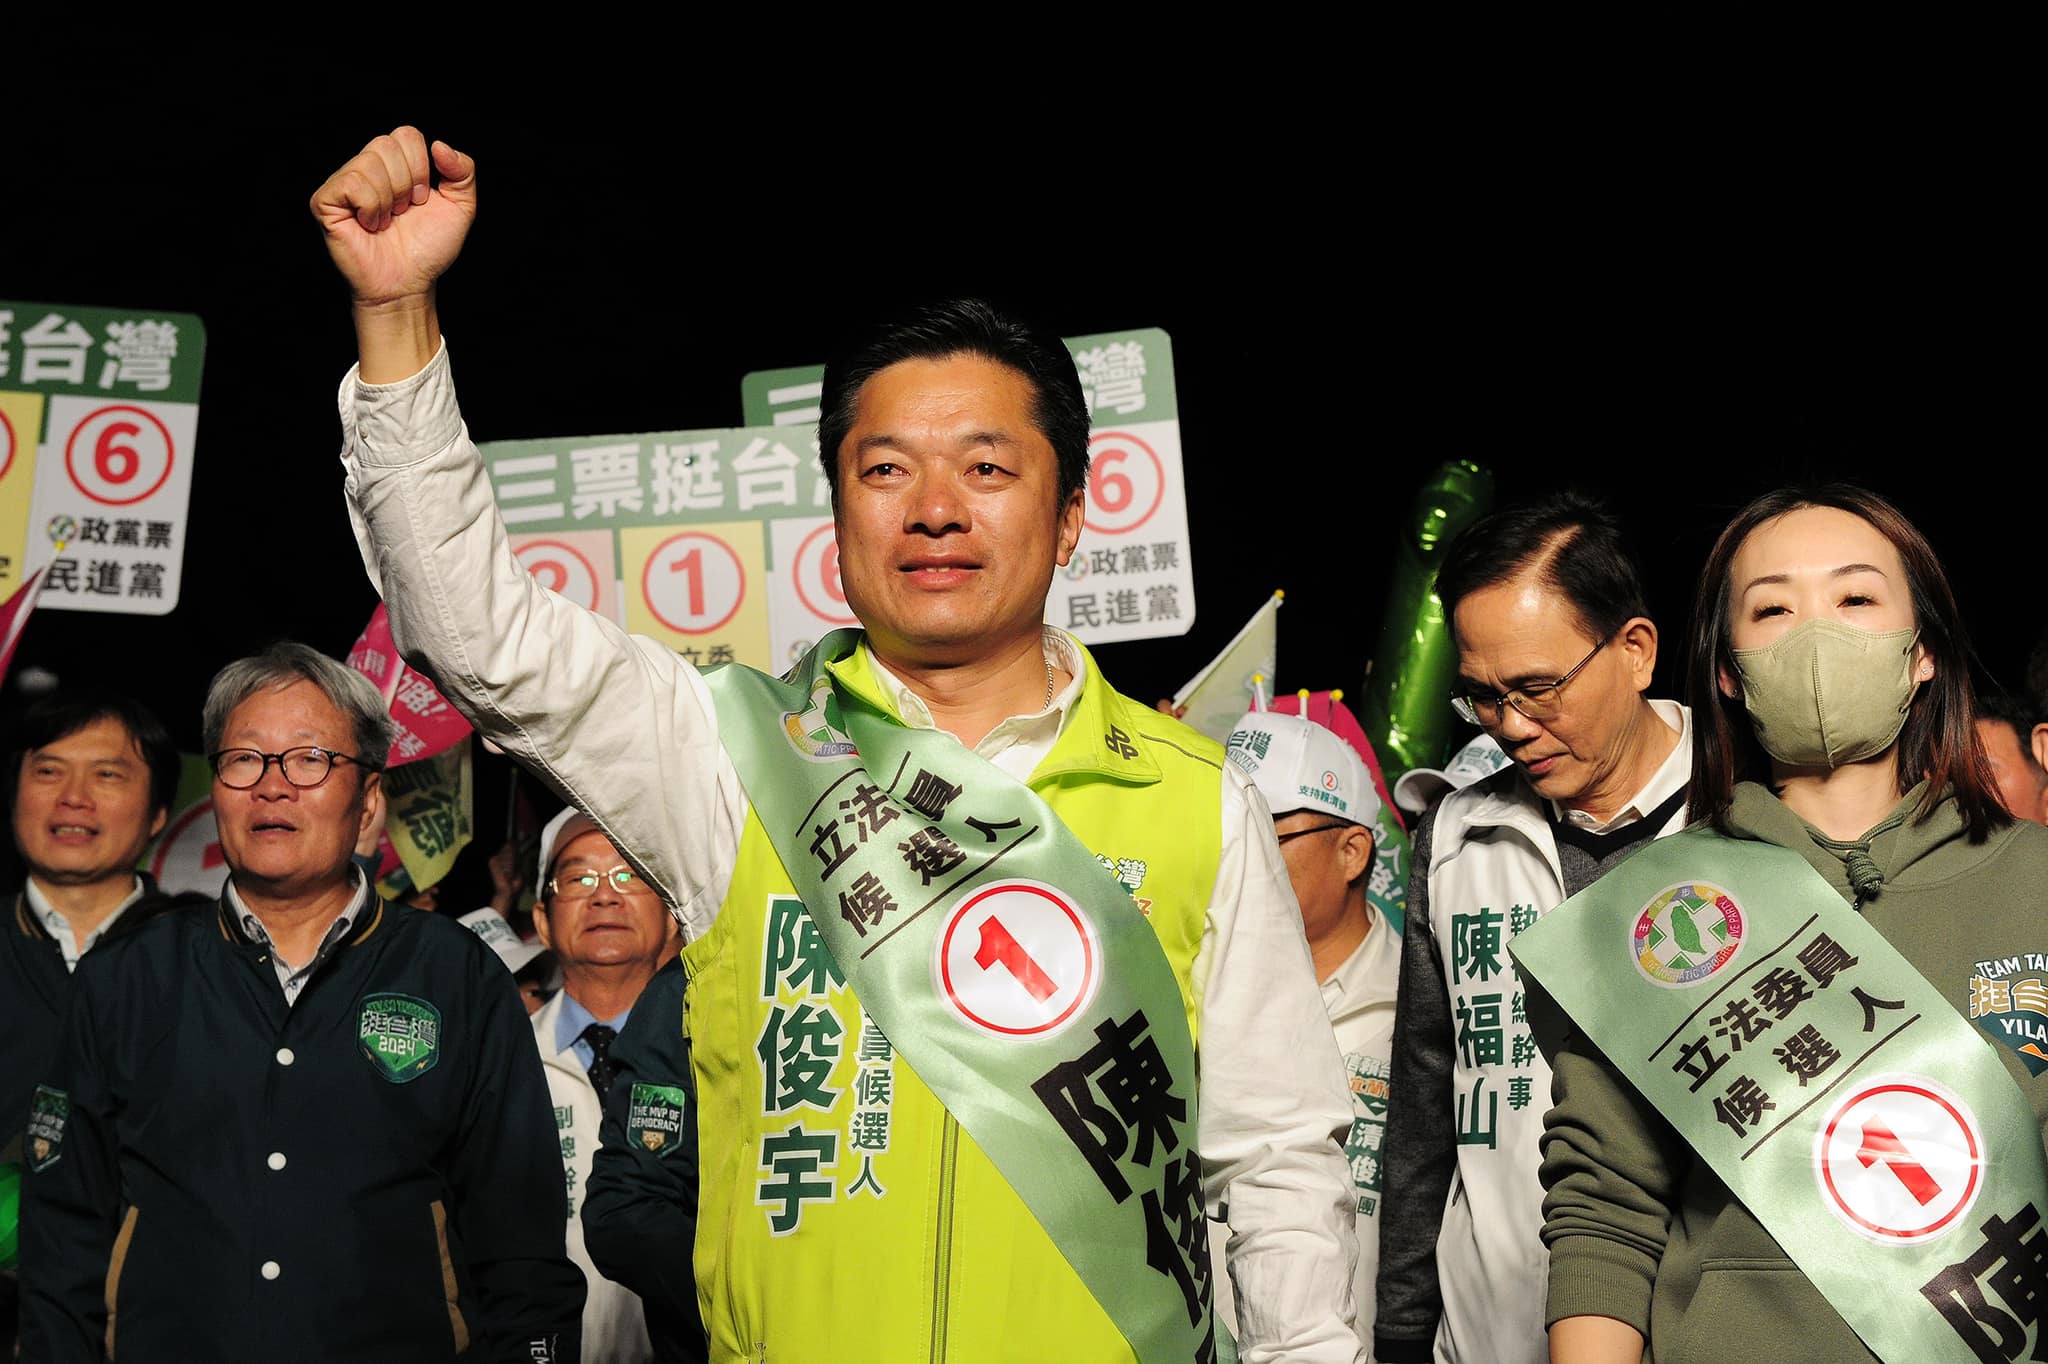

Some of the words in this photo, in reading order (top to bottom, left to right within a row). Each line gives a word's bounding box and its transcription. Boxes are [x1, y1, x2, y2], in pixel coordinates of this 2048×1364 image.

[0, 310, 179, 391] 台灣
[493, 438, 834, 524] 三票挺台
[80, 516, 173, 550] 政黨票
[1091, 541, 1180, 577] 政黨票
[45, 558, 166, 599] 民進黨
[1066, 585, 1182, 630] 民進黨
[810, 768, 963, 882] 立法員
[838, 815, 1022, 938] 候選人
[1506, 904, 1539, 1111] 執總幹事
[1976, 957, 2022, 979] TEAM
[379, 1036, 416, 1057] 2024
[1451, 908, 1504, 1150] 陳福山
[1671, 932, 1859, 1093] 立法委員
[756, 899, 850, 1233] 陳俊宇
[848, 1007, 893, 1196] 員候選人
[1712, 986, 1906, 1139] 候選人
[631, 1117, 680, 1133] DEMOCRACY
[634, 1106, 648, 1117] THE
[650, 1106, 668, 1118] MVP
[669, 1109, 681, 1121] OF
[1030, 1008, 1216, 1364] 陳俊
